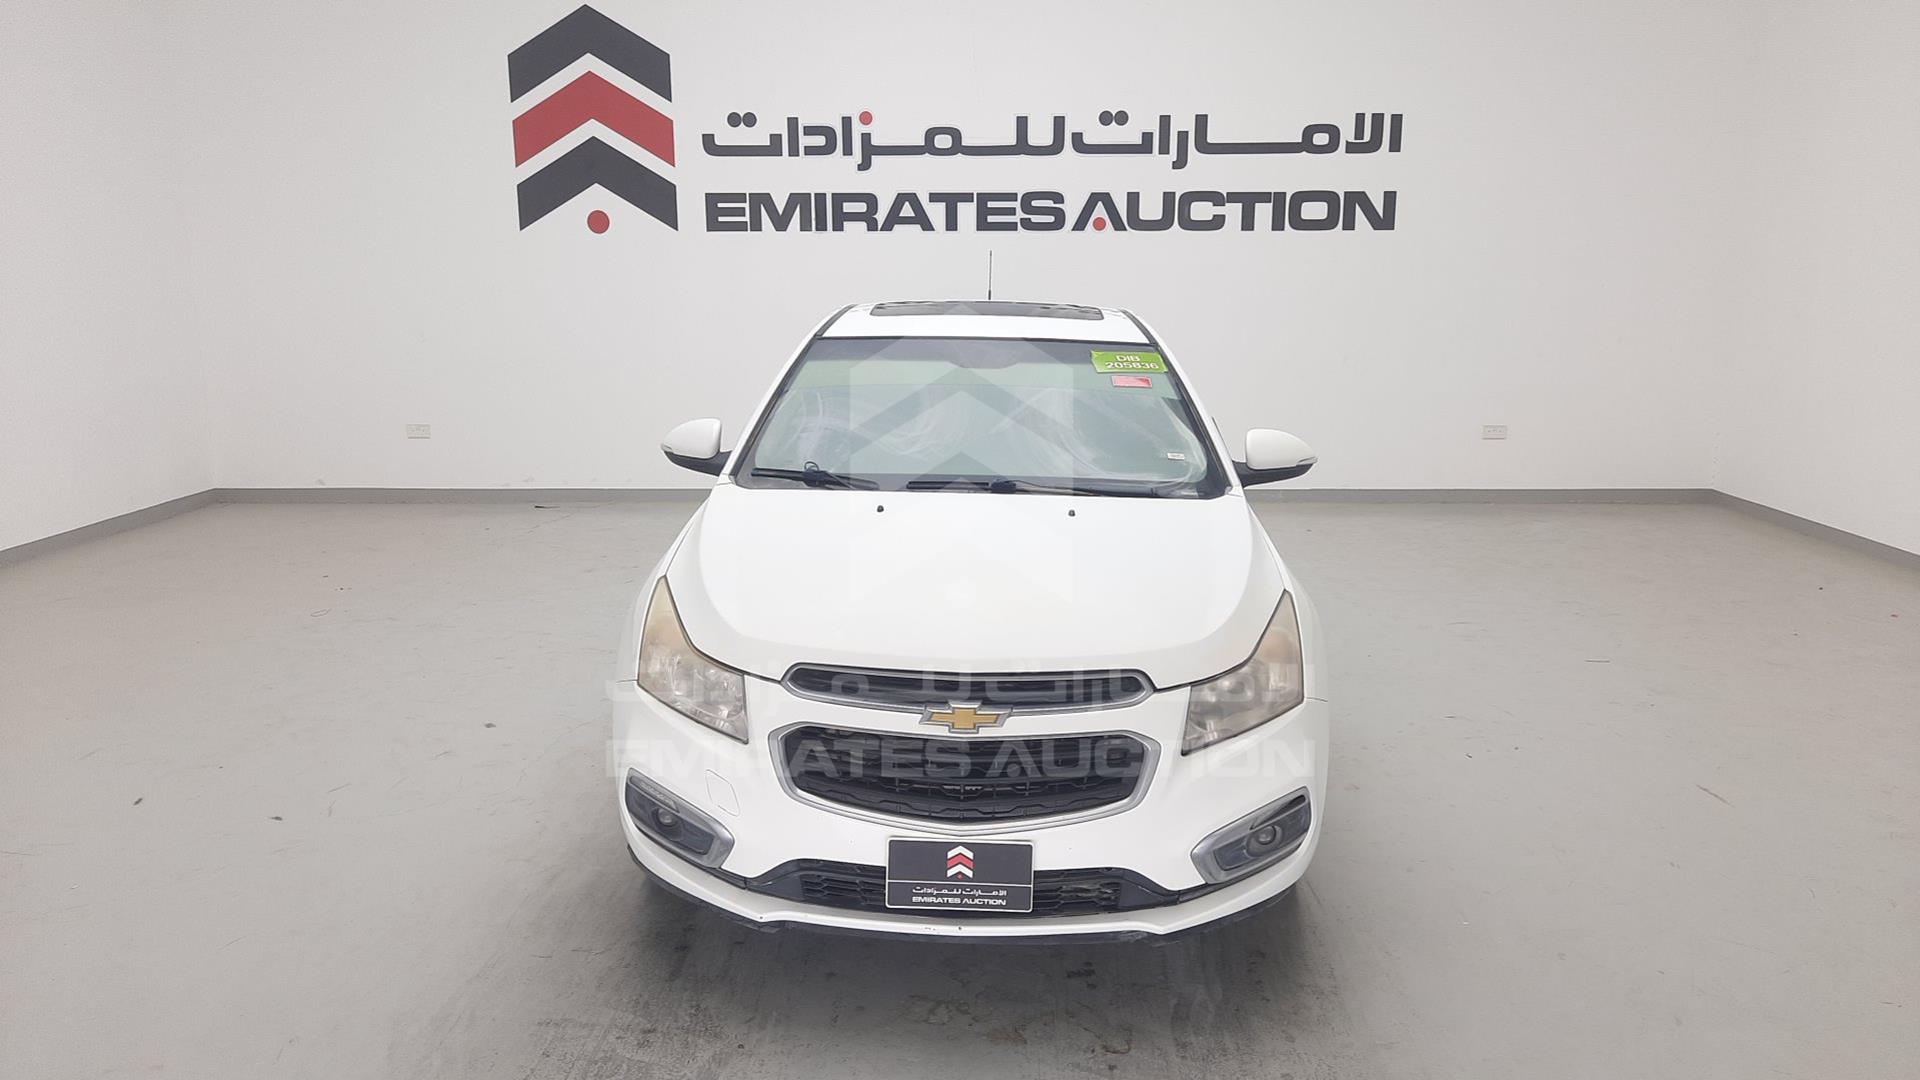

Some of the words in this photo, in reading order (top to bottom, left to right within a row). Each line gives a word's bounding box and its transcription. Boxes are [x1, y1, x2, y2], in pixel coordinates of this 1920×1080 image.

[701, 111, 1065, 171] للمزادات
[1071, 110, 1403, 169] الامارات
[705, 191, 1066, 232] EMIRATES
[1071, 190, 1397, 231] AUCTION
[912, 896, 961, 904] EMIRATES
